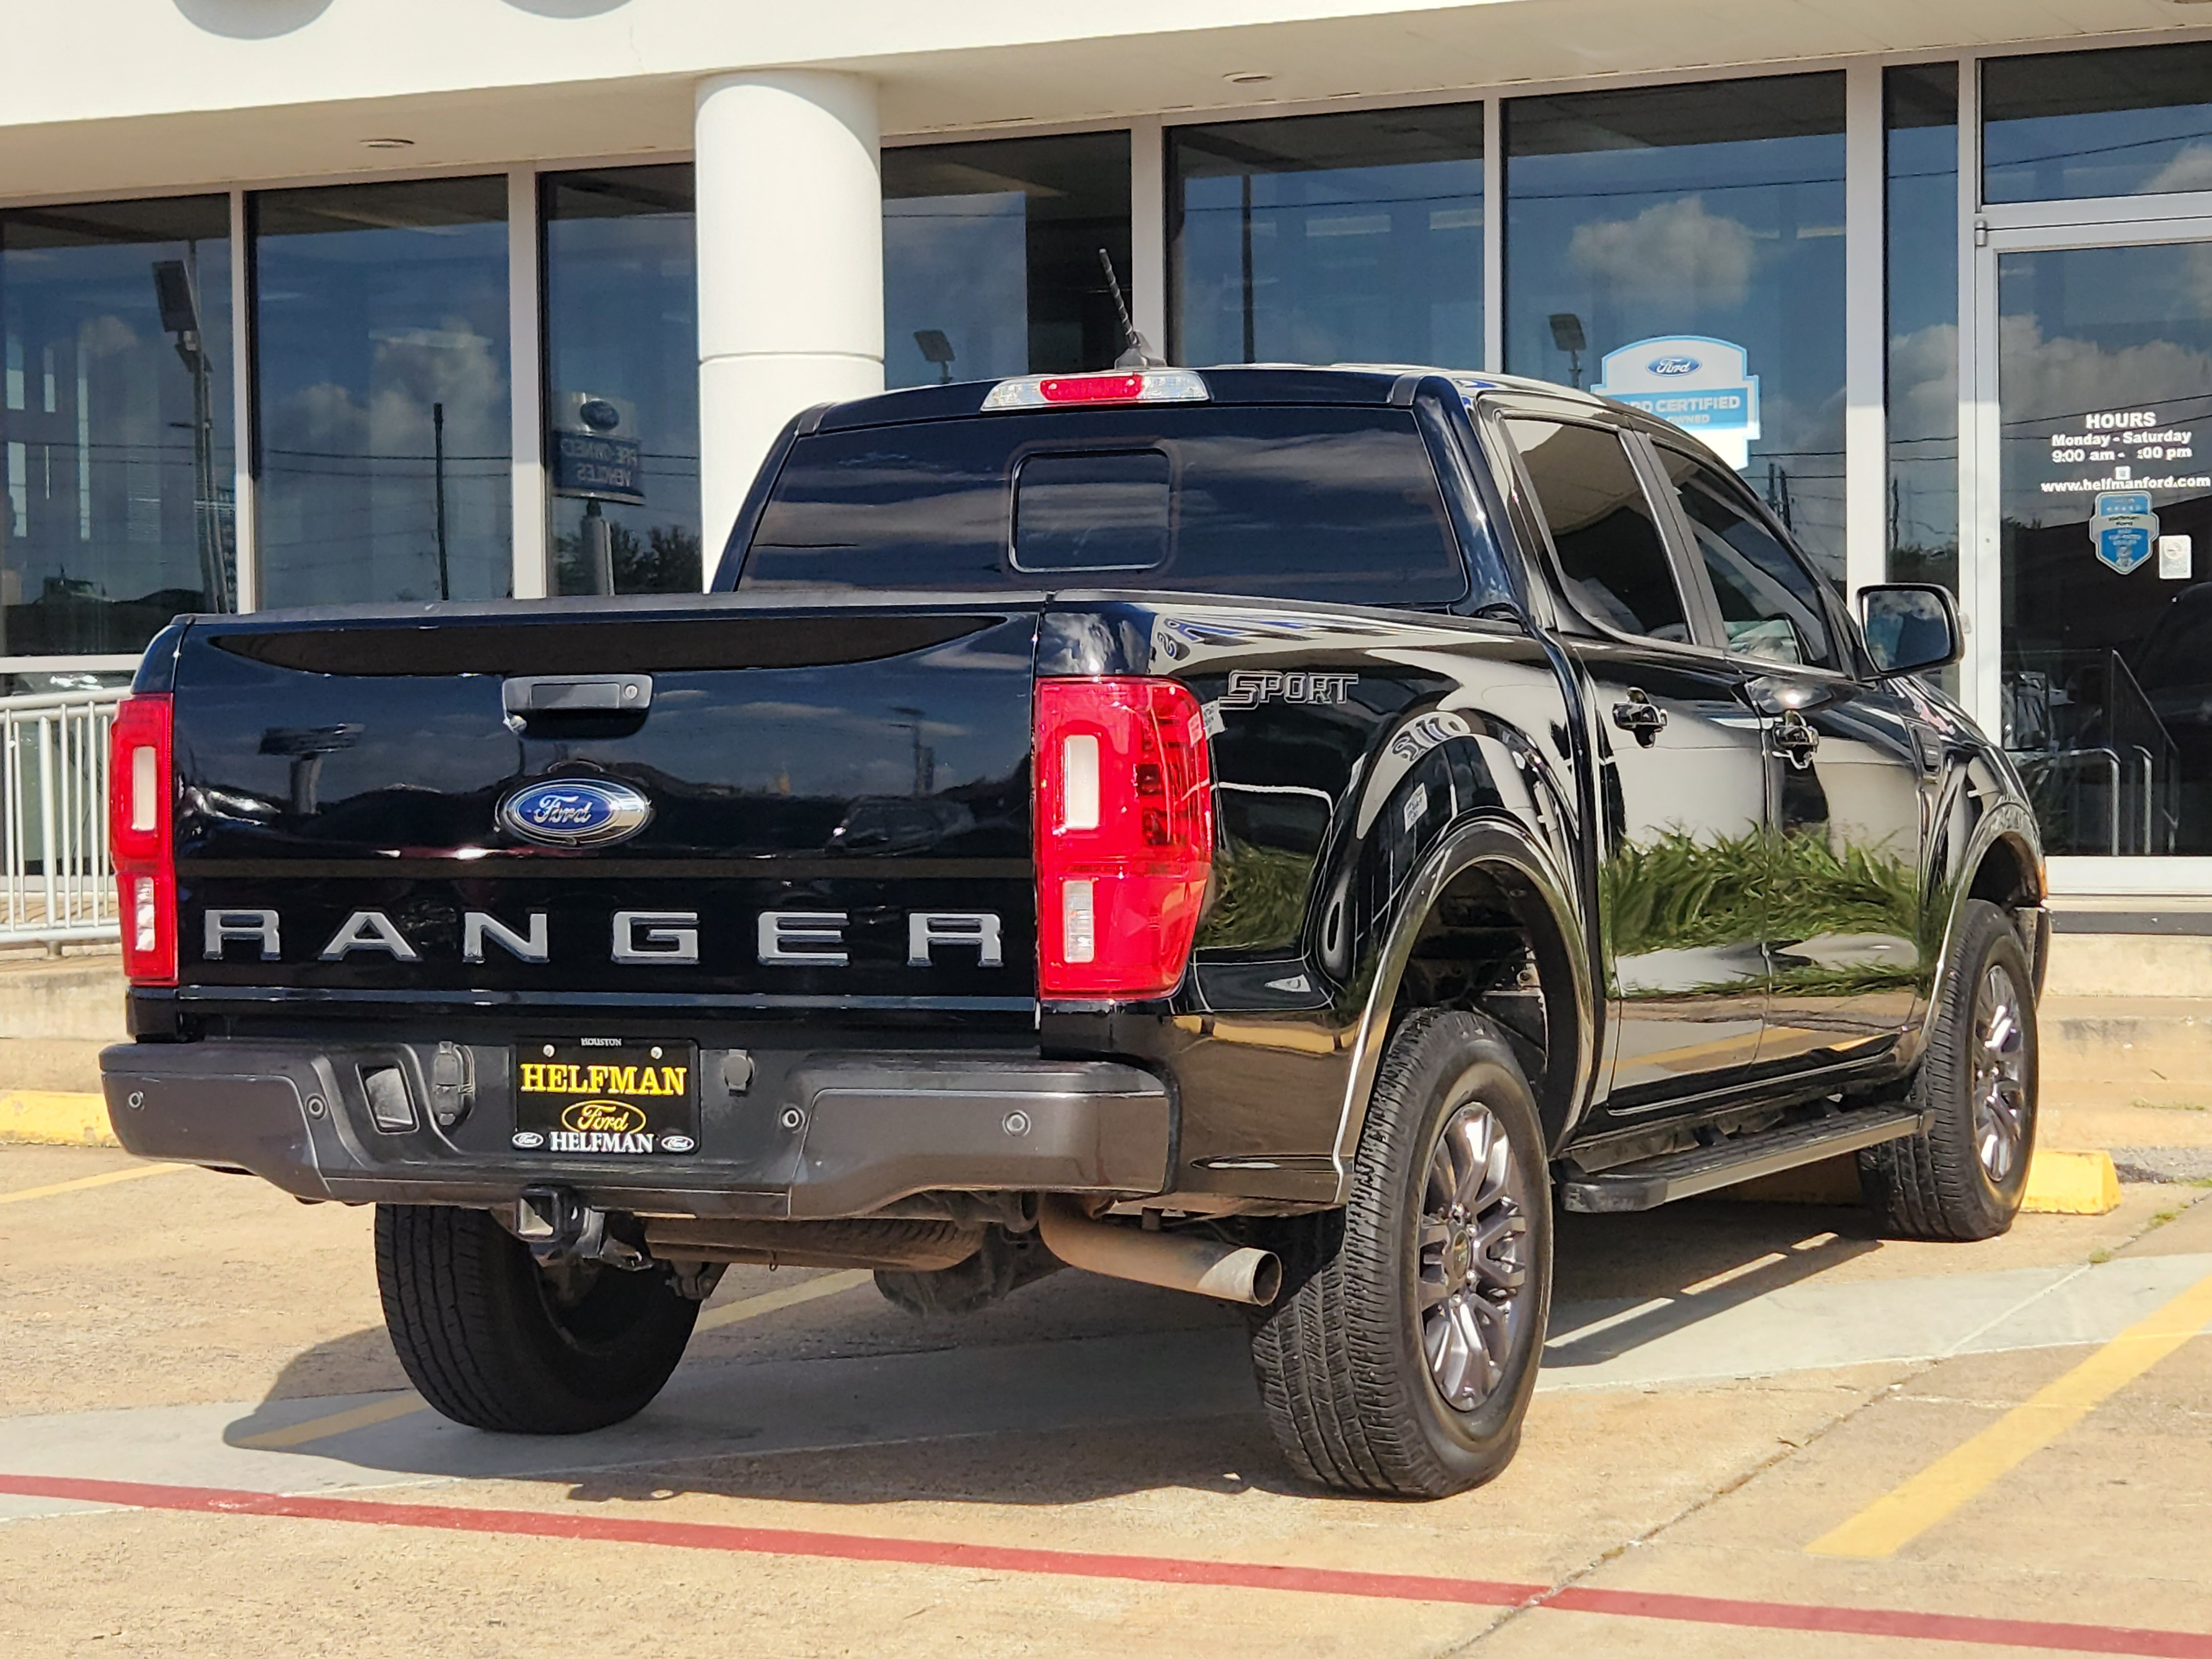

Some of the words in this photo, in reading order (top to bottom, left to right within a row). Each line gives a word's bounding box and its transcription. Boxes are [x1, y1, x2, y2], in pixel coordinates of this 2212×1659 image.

[1656, 358, 1691, 373] Ford
[1656, 395, 1740, 412] CERTIFIED
[2085, 411, 2157, 429] HOURS
[2051, 433, 2111, 448] Monday
[2123, 429, 2192, 444] Saturday
[2051, 449, 2085, 464] 9:00
[2088, 450, 2116, 461] am
[2165, 446, 2193, 461] pm
[2040, 475, 2212, 493] www.helfmanford.com
[1218, 669, 1359, 711] SPORT
[533, 794, 594, 824] Ford
[203, 909, 1003, 968] RANGER
[580, 1038, 622, 1047] HOUSTON
[520, 1063, 687, 1096] HELFMAN
[577, 1104, 629, 1131] Ford
[549, 1131, 655, 1153] HELFMAN
